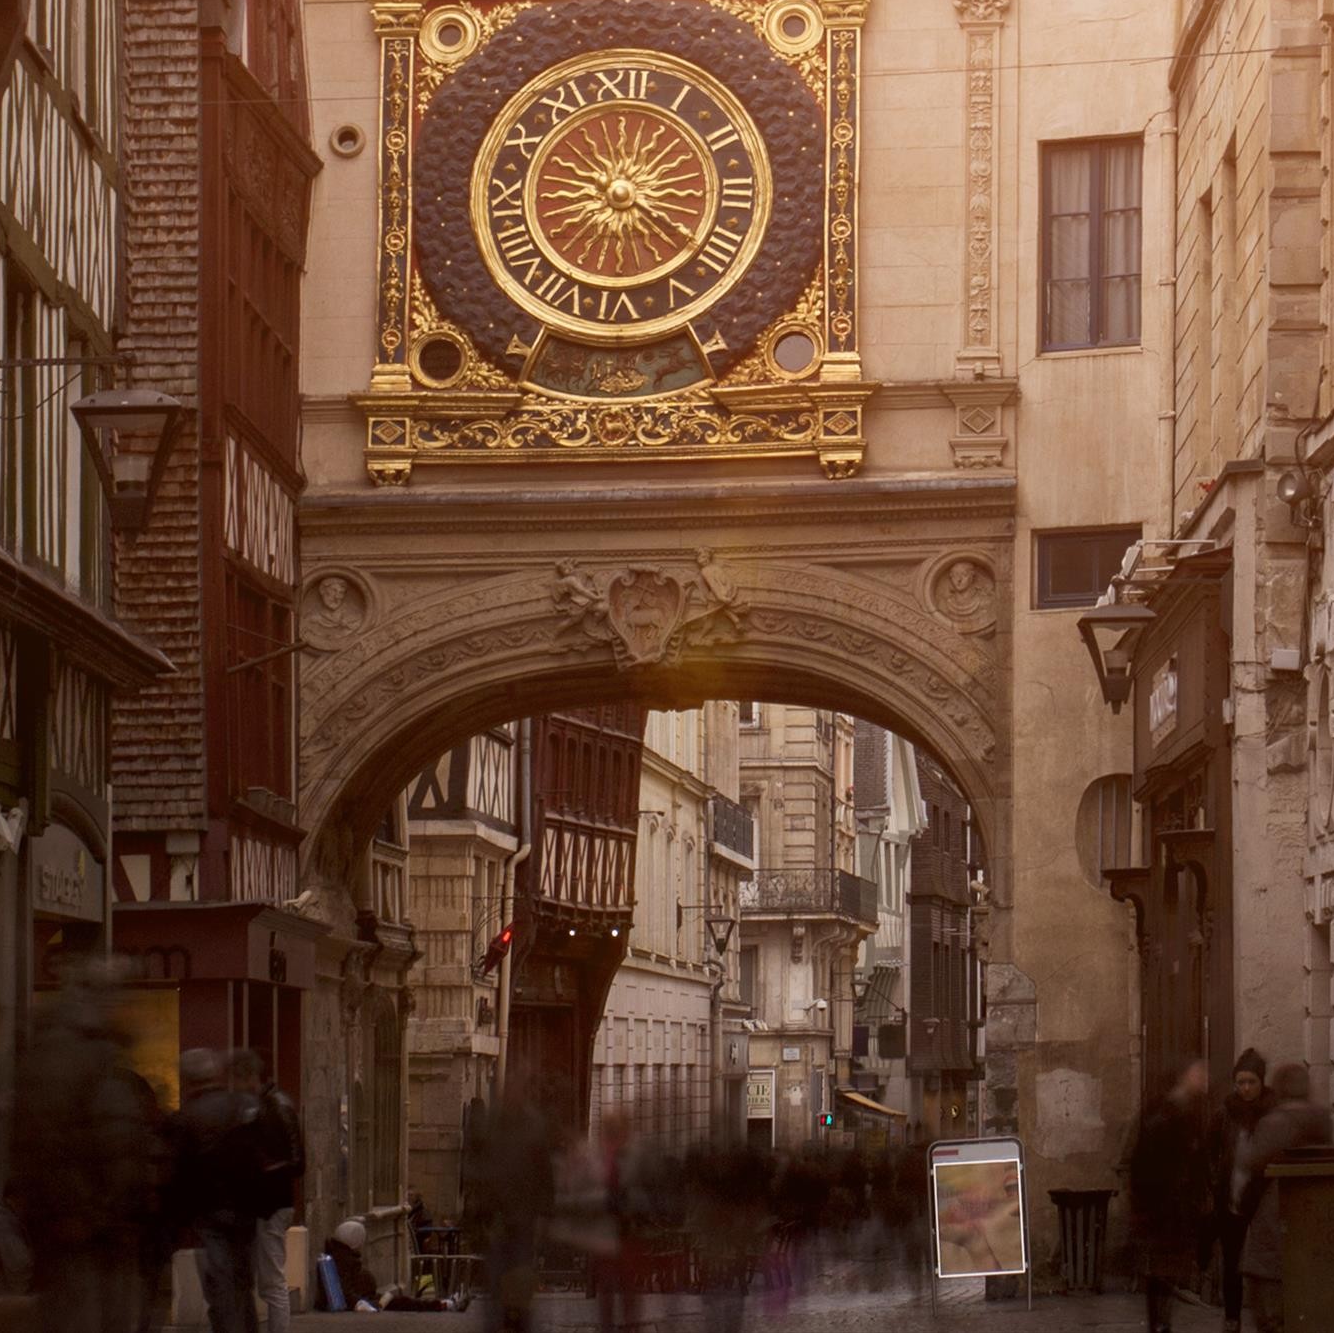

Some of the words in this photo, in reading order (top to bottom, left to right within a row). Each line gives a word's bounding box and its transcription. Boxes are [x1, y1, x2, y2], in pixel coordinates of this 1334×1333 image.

[539, 79, 588, 126] XI
[594, 69, 650, 101] XII
[670, 84, 692, 112] I
[504, 122, 543, 160] X
[705, 123, 740, 152] II
[491, 178, 522, 219] IX
[721, 176, 753, 210] III
[496, 223, 542, 287] VIII
[697, 223, 744, 275] IIII
[534, 272, 581, 317] VII
[598, 290, 642, 322] VI
[668, 277, 698, 309] V
